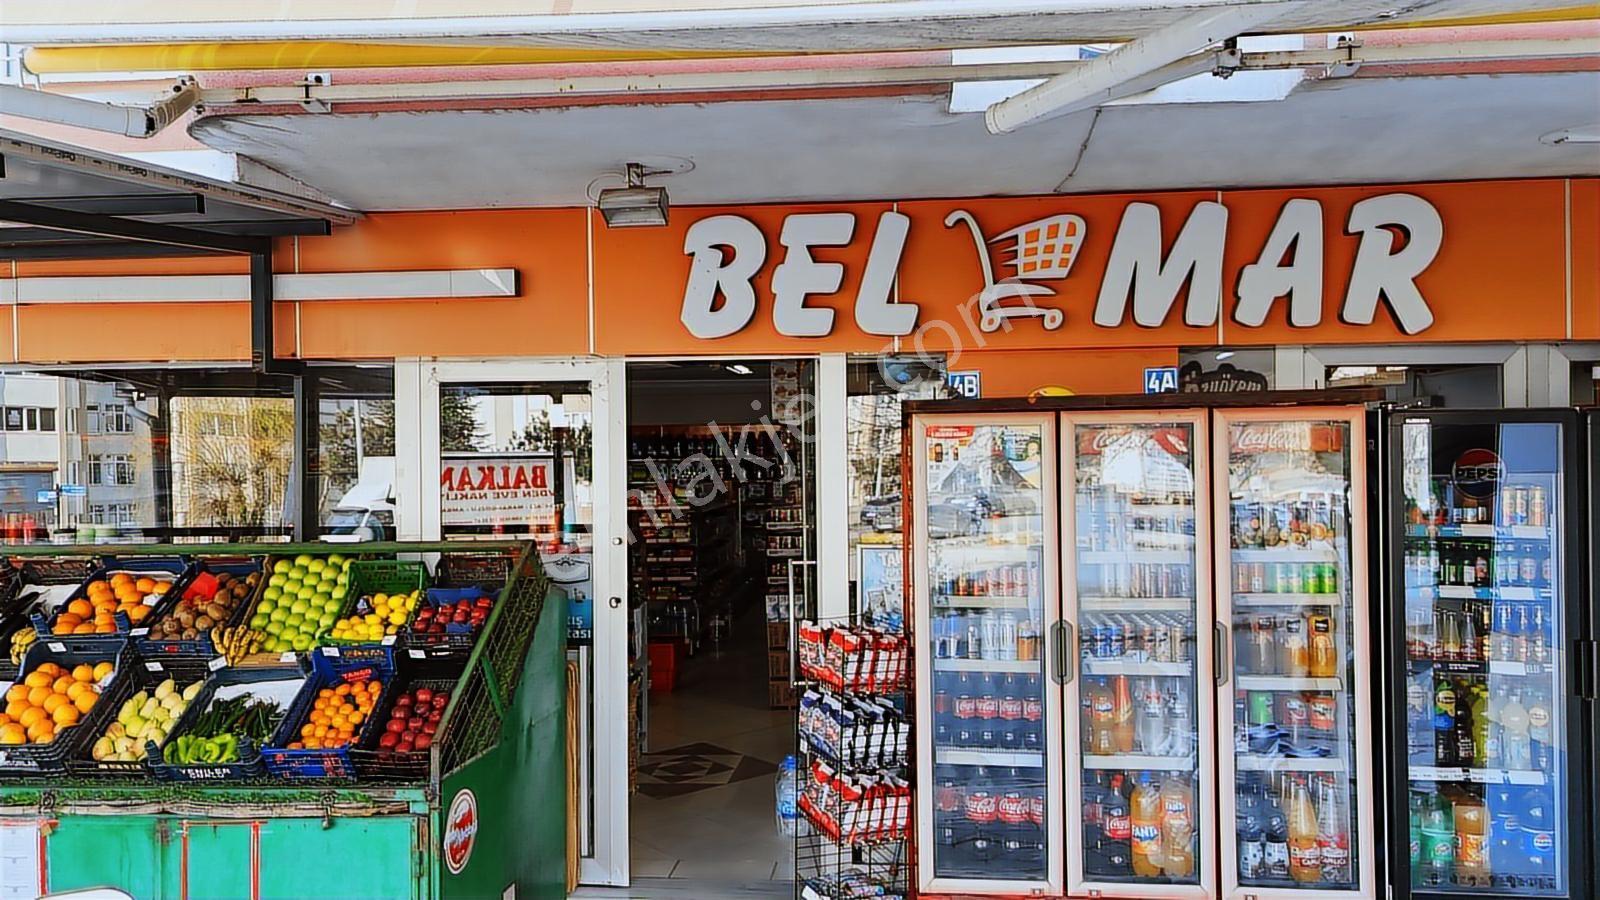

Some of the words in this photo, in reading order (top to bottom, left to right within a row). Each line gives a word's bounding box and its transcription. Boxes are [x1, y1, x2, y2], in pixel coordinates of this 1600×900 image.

[681, 210, 920, 340] BEL
[1093, 192, 1444, 336] MAR
[953, 375, 977, 398] 4B
[1149, 371, 1175, 393] 4A
